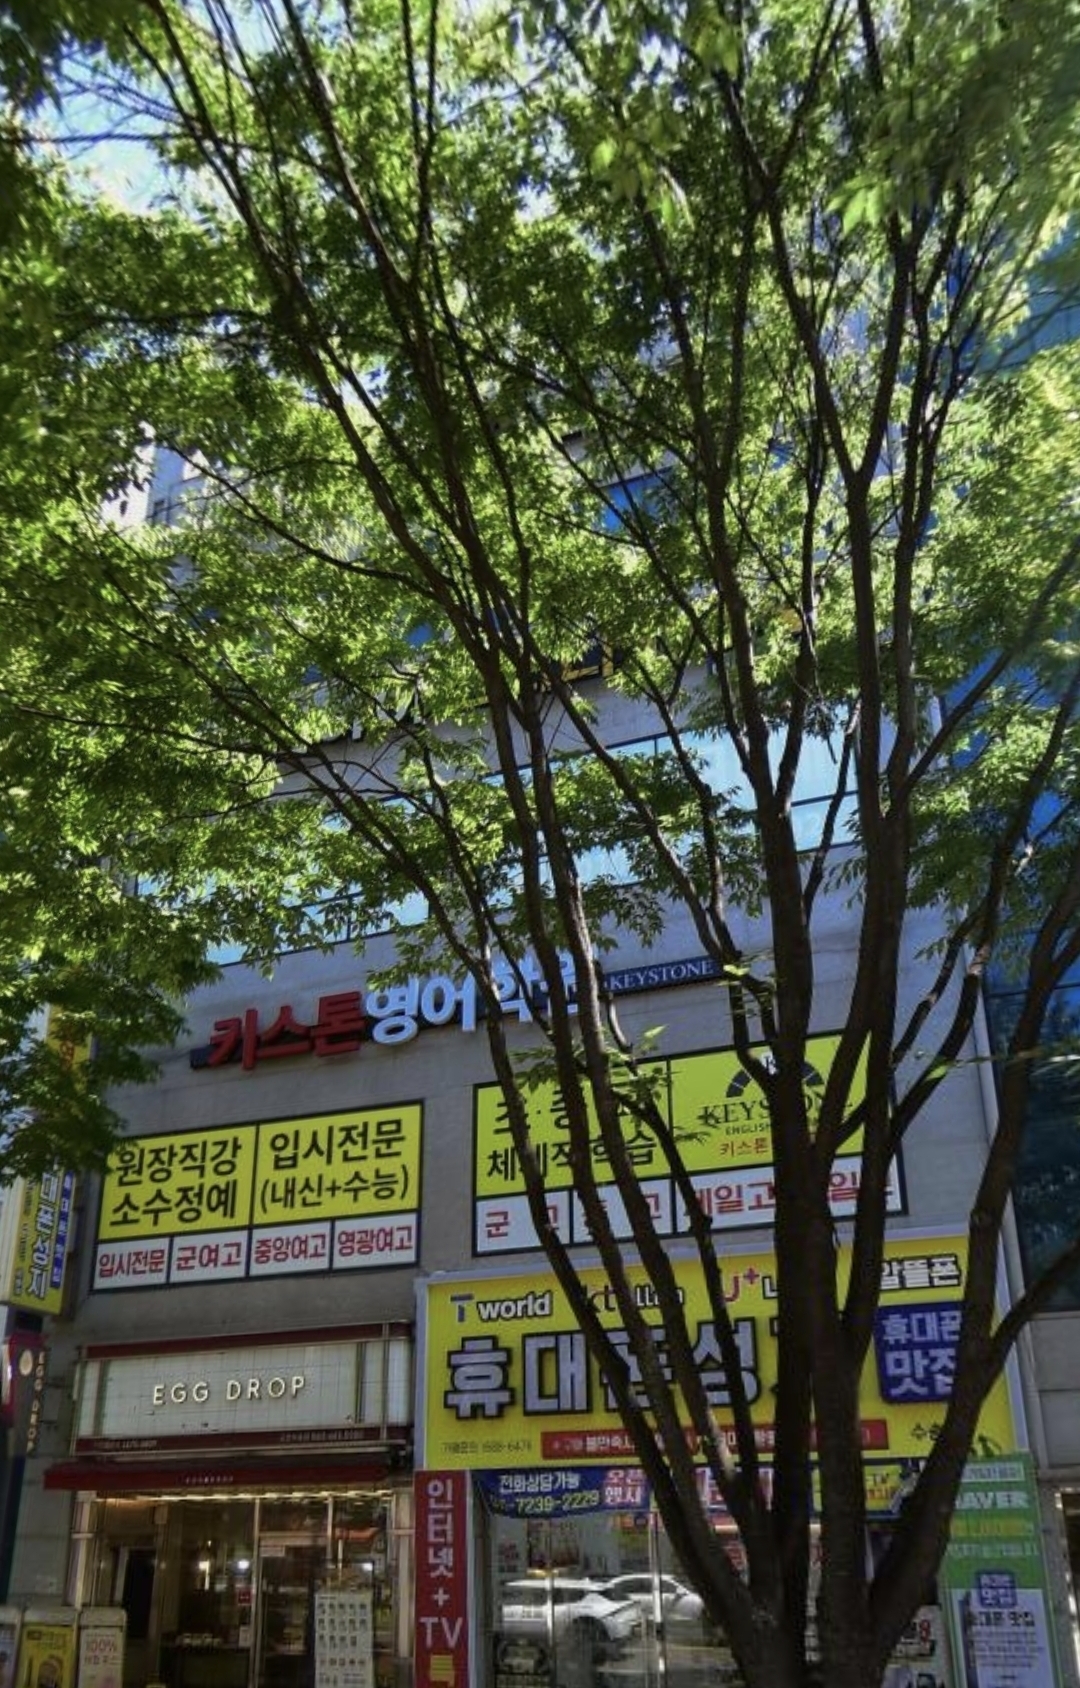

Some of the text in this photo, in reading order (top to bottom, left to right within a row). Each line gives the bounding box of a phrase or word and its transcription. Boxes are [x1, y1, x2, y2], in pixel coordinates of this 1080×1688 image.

[609, 960, 714, 990] KEYSTONE
[271, 1119, 406, 1170] 입시전문
[116, 1137, 242, 1187] 원장직강
[109, 1180, 237, 1227] 소수정예
[260, 1164, 410, 1214] (내신+수능)
[176, 1242, 242, 1270] 군여고
[253, 1234, 327, 1265] 중앙여고
[337, 1226, 413, 1258] 영광여고
[98, 1249, 166, 1277] 입시전문
[477, 1291, 552, 1323] world
[153, 1375, 306, 1406] EGG DROP
[420, 1616, 463, 1649] TV
